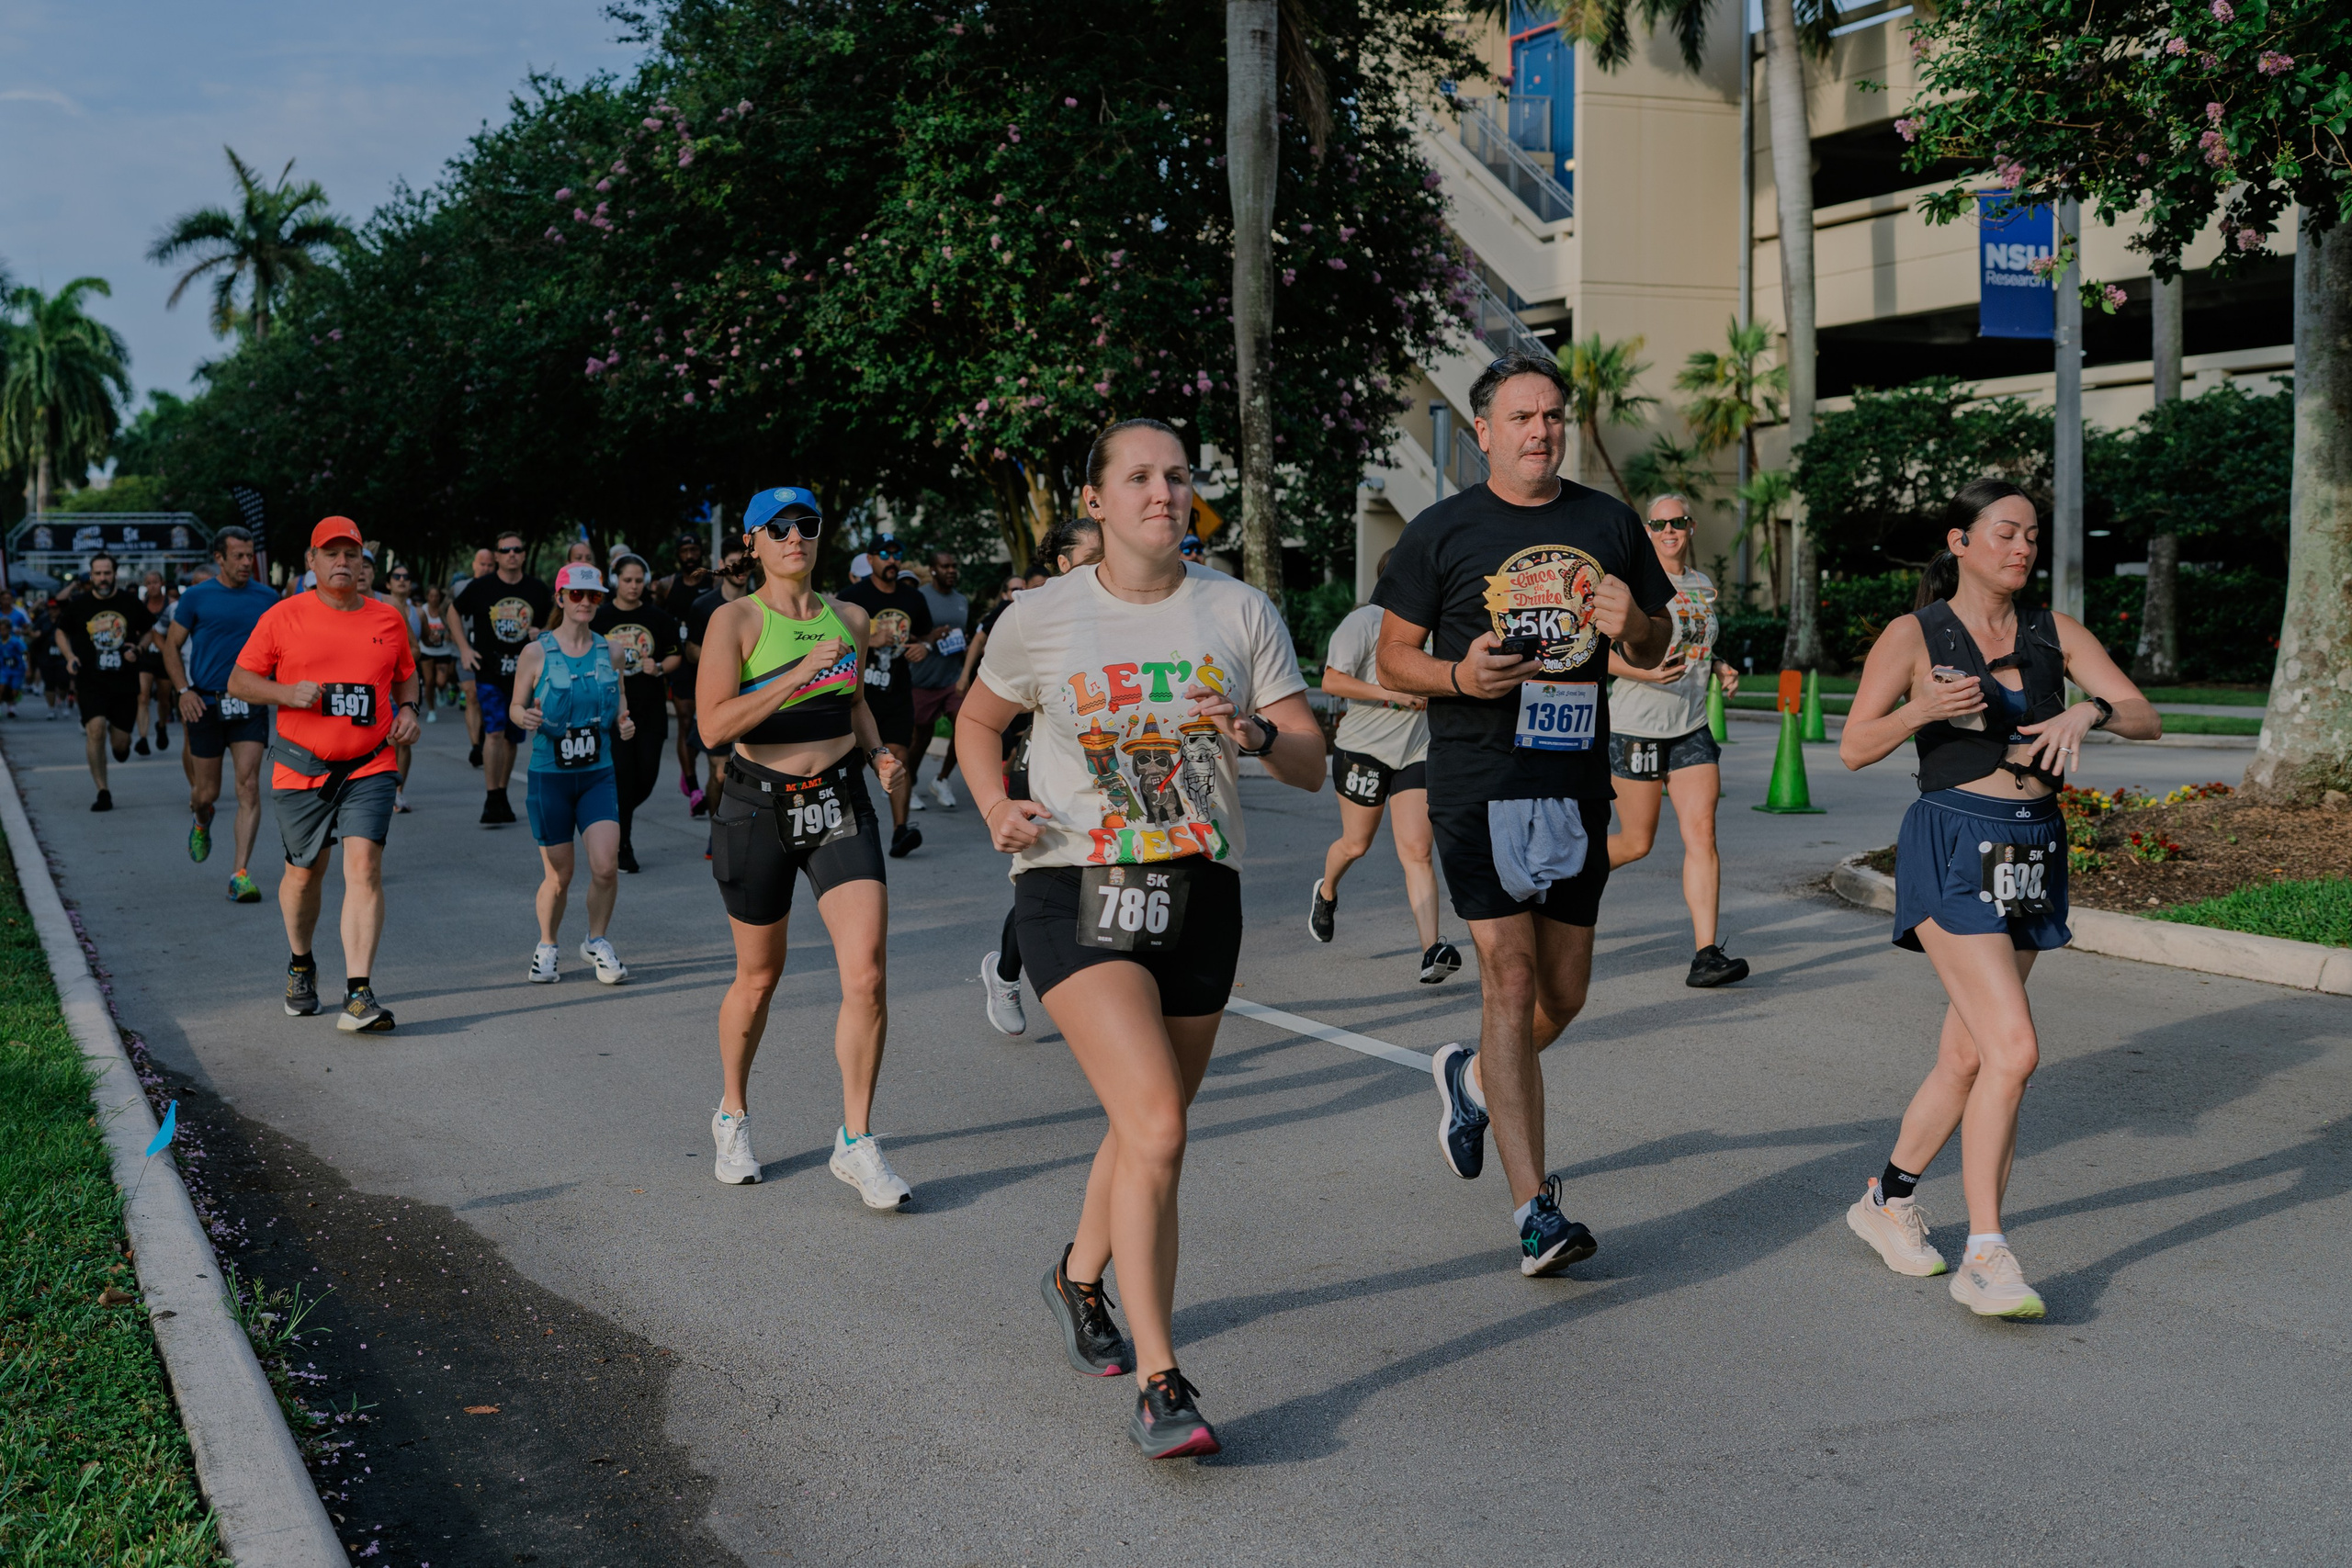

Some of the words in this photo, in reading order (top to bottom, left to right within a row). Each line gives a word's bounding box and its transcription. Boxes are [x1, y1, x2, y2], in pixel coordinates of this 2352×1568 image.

[1984, 243, 2049, 271] NSU
[1985, 270, 2046, 288] Research
[1510, 569, 1558, 588] Cinco
[1534, 583, 1545, 592] de
[1513, 590, 1564, 606] Drinko
[1521, 610, 1561, 639] 5K
[501, 658, 517, 672] 73
[864, 668, 890, 687] 969
[354, 685, 366, 694] 5K
[1068, 660, 1225, 716] LET'S
[331, 693, 369, 716] 597
[1526, 702, 1593, 733] 13677
[580, 728, 591, 737] 5K
[2009, 732, 2022, 740] alo
[560, 736, 595, 761] 944
[1647, 742, 1657, 751] 5K
[1631, 750, 1658, 774] 811
[1367, 770, 1380, 779] 5K
[1346, 771, 1380, 797] 812
[818, 787, 835, 800] 5K
[787, 798, 842, 837] 796
[2016, 807, 2031, 818] alo
[2029, 850, 2044, 862] 5K
[1146, 873, 1170, 887] 5K
[1994, 863, 2045, 901] 698
[1098, 886, 1170, 934] 786
